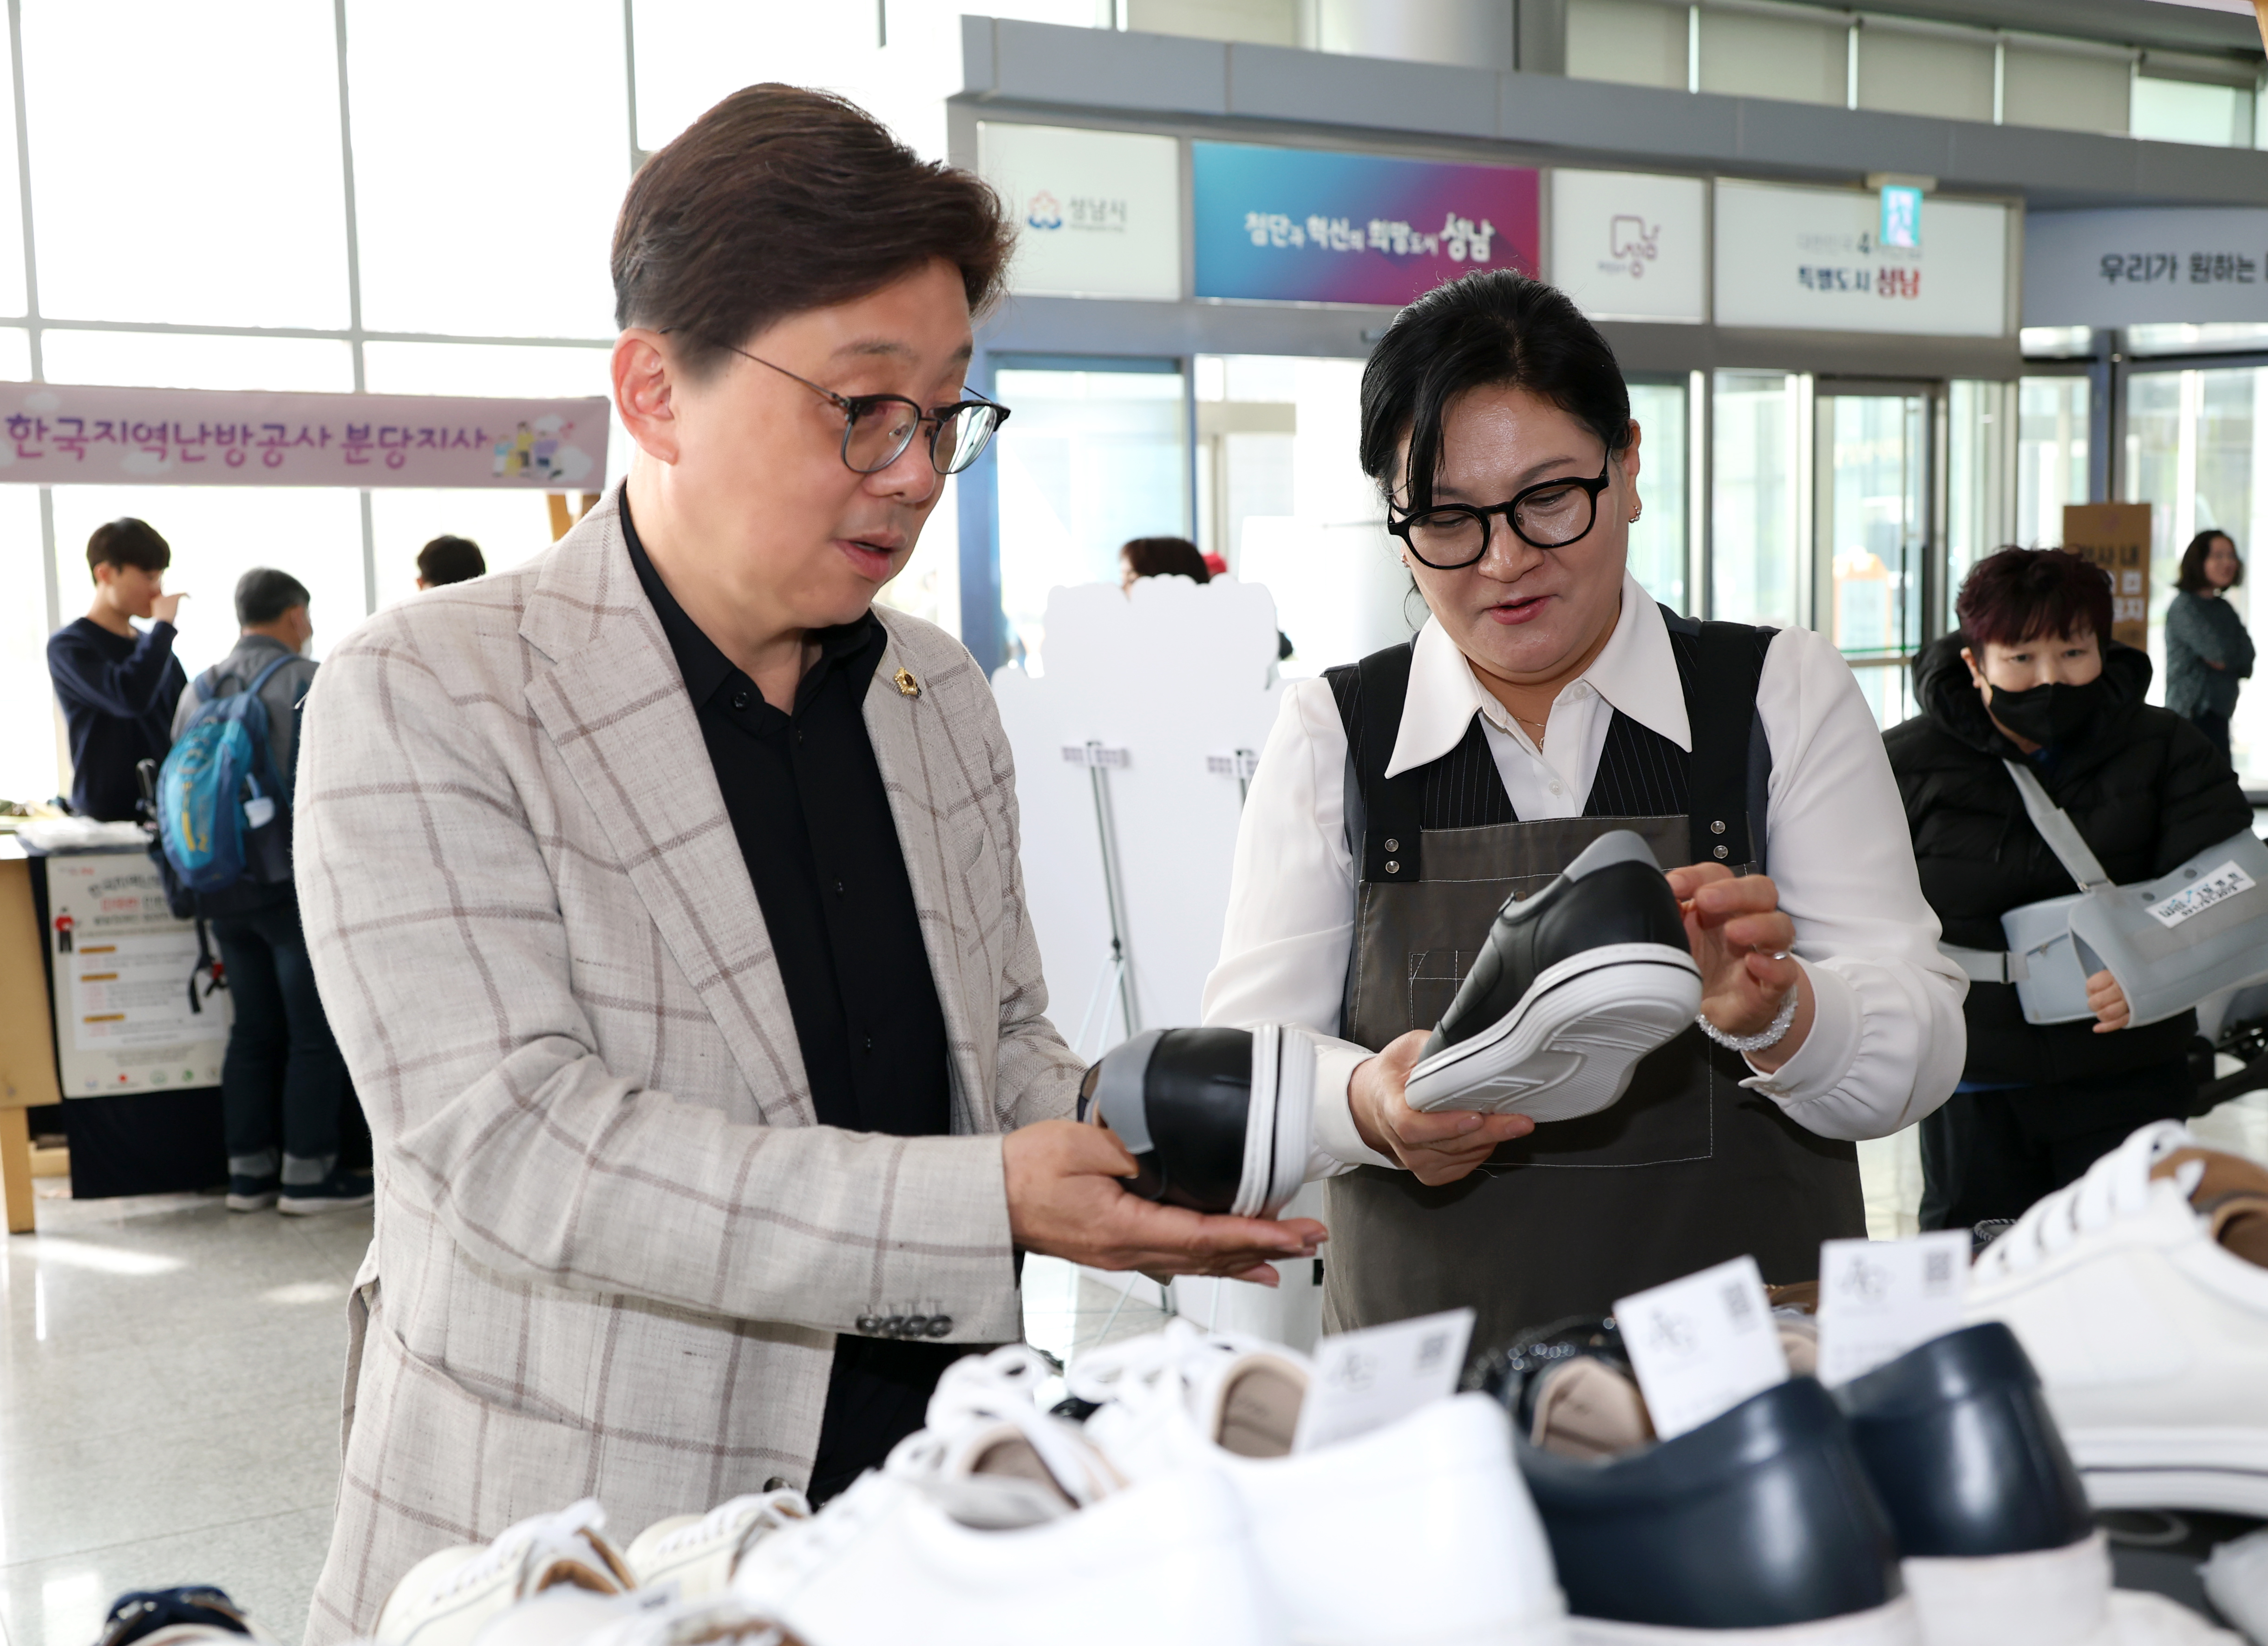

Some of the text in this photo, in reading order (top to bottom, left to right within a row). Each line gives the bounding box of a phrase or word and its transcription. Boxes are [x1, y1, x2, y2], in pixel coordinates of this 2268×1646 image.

[1068, 195, 1128, 223] 성남시
[1245, 211, 1497, 262] 첨단과 혁신의 희망도시 성남
[1798, 264, 1921, 299] 특별도시 성남
[2101, 253, 2178, 284] 우리가
[2190, 252, 2256, 284] 원하는
[6, 413, 489, 470] 한국지역난방공사 분당지사
